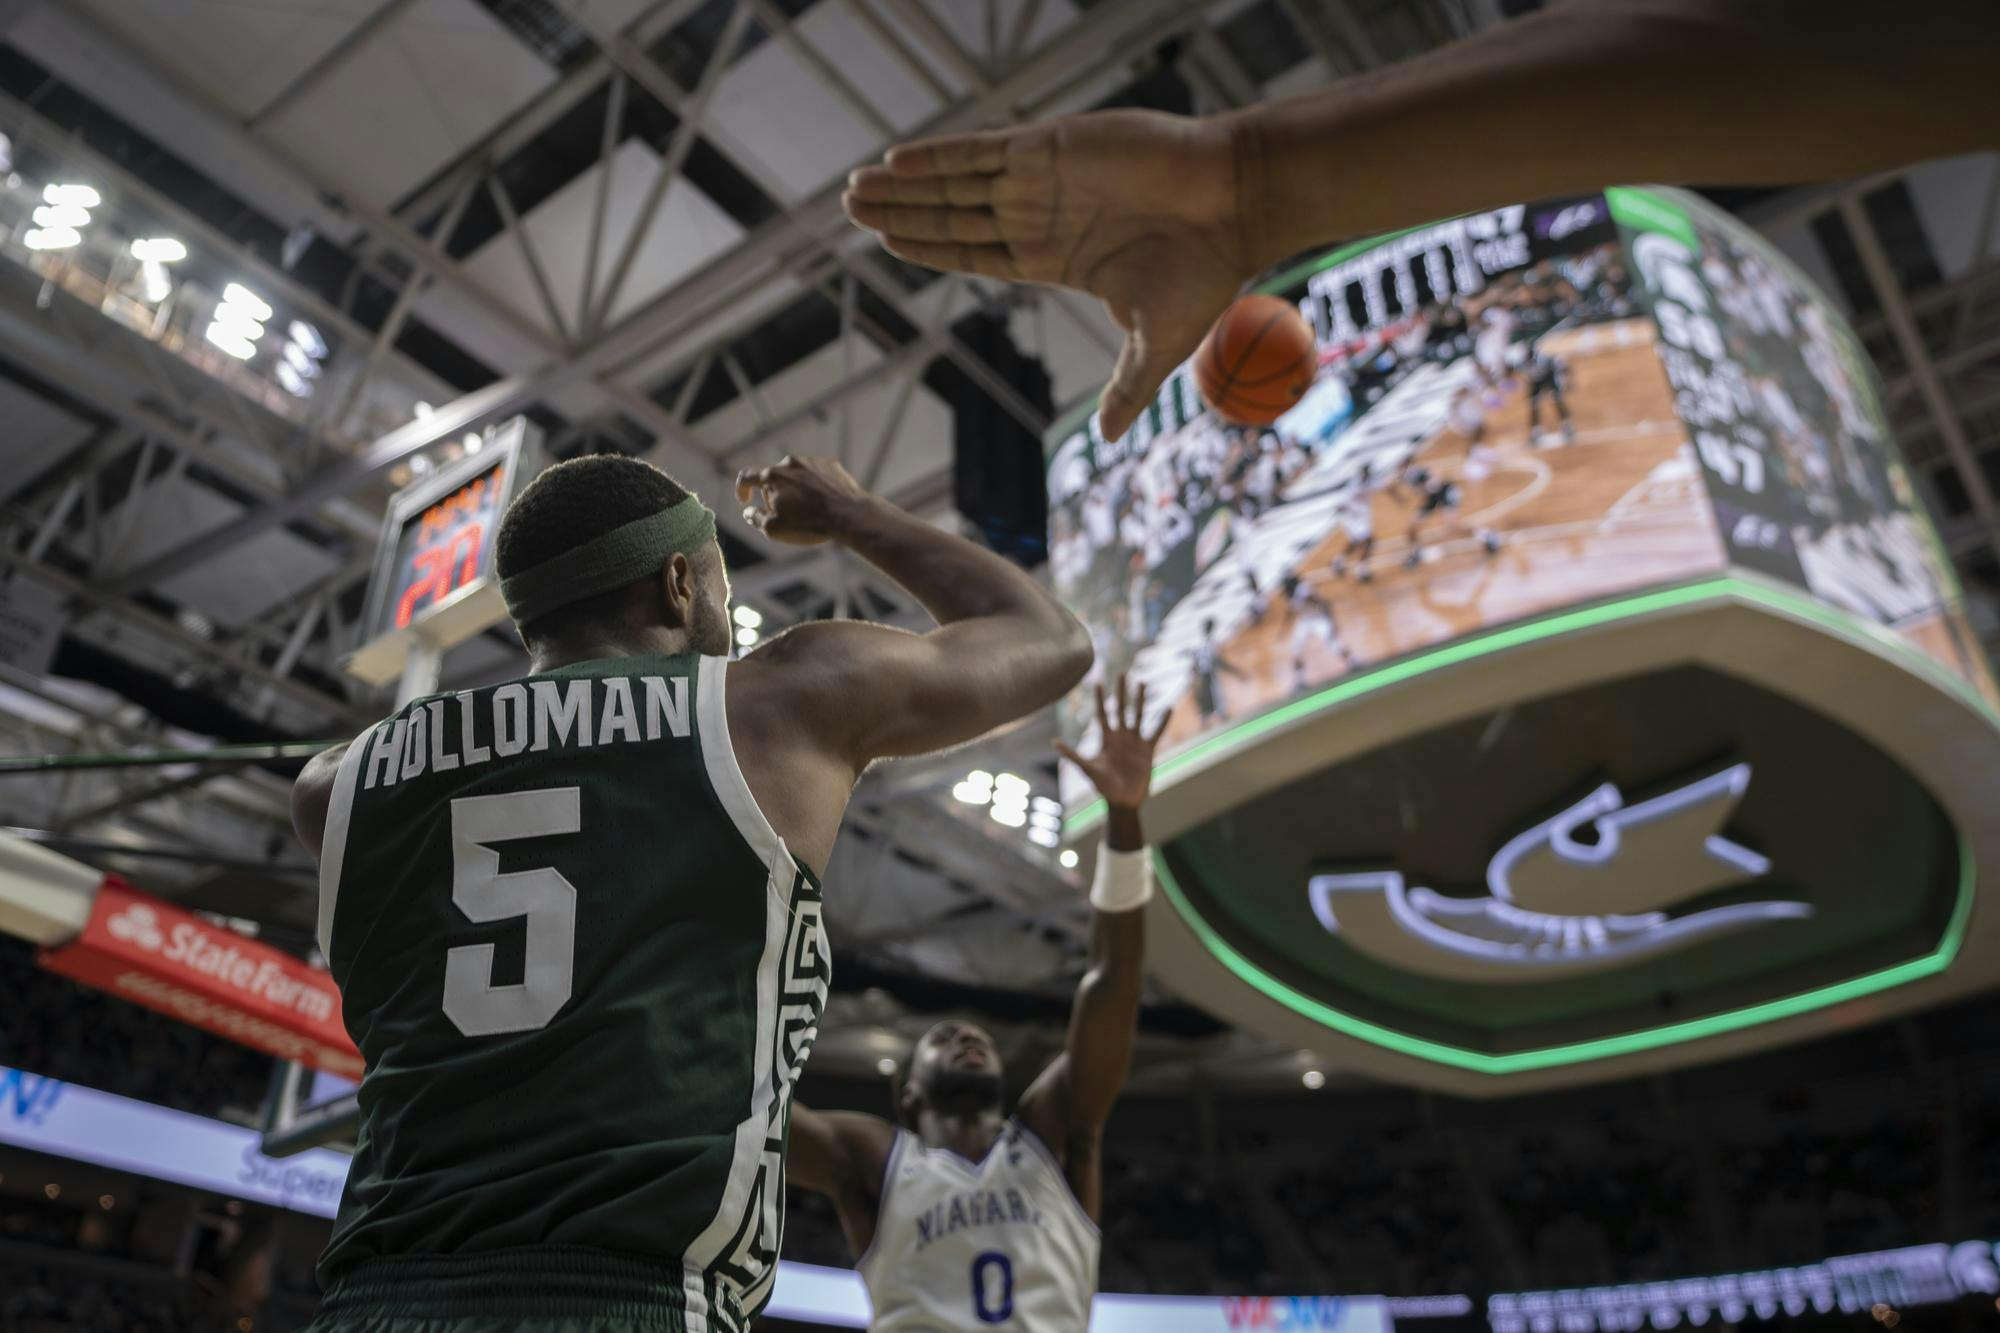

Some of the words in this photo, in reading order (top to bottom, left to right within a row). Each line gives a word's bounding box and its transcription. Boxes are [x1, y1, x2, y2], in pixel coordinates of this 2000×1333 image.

[364, 675, 691, 791] HOLLOMAN
[442, 786, 581, 1037] 5
[971, 1250, 1014, 1324] 0
